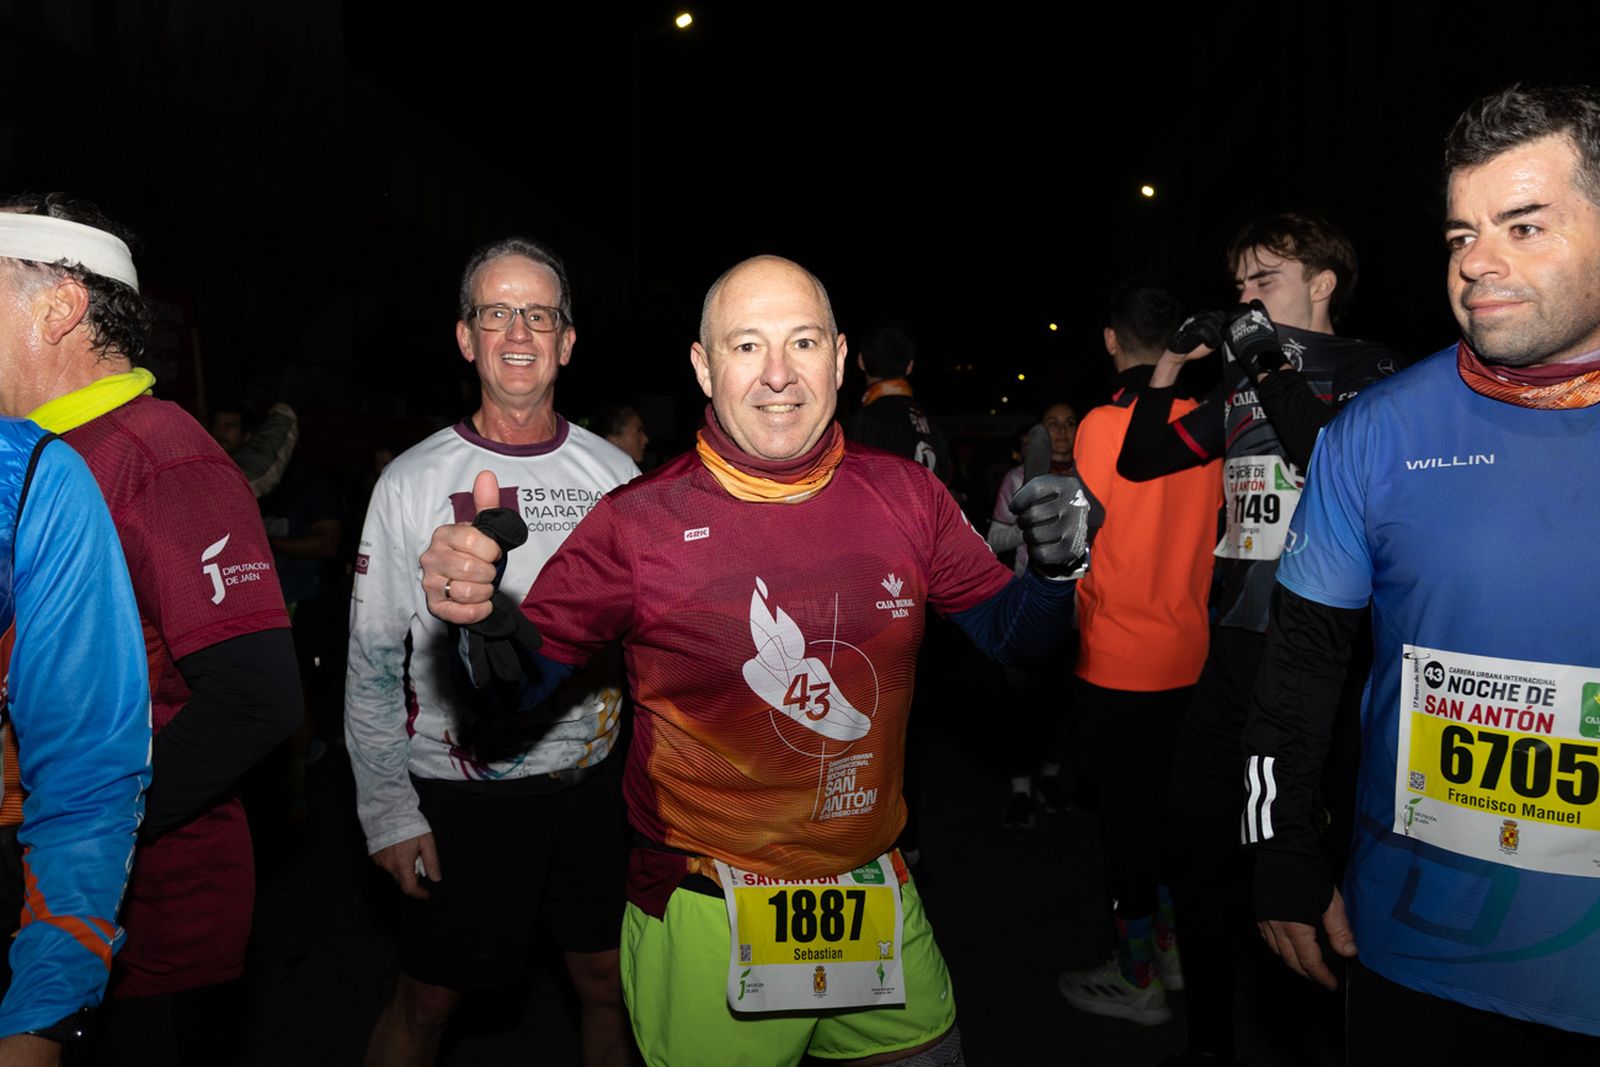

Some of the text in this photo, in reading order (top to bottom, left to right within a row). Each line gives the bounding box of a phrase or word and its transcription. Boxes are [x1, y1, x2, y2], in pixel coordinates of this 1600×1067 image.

[1406, 454, 1495, 470] WILLIN
[1254, 467, 1265, 478] DE
[522, 488, 602, 502] 35 MEDIA
[223, 562, 270, 576] DIPUTACIÓN
[226, 573, 260, 585] DE JAÉN
[1425, 666, 1556, 686] 43 CARRERA URBANA INTERNACIONAL
[783, 673, 830, 721] 43
[1447, 675, 1556, 706] NOCHE DE
[1424, 694, 1555, 734] SAN ANTÓN
[1440, 725, 1599, 805] 6705
[825, 776, 856, 797] SAN
[820, 787, 878, 816] ANTÓN
[1448, 787, 1581, 824] Francisco Manuel
[743, 873, 780, 886] SAN
[768, 889, 866, 943] 1887
[794, 948, 843, 961] Sebastian
